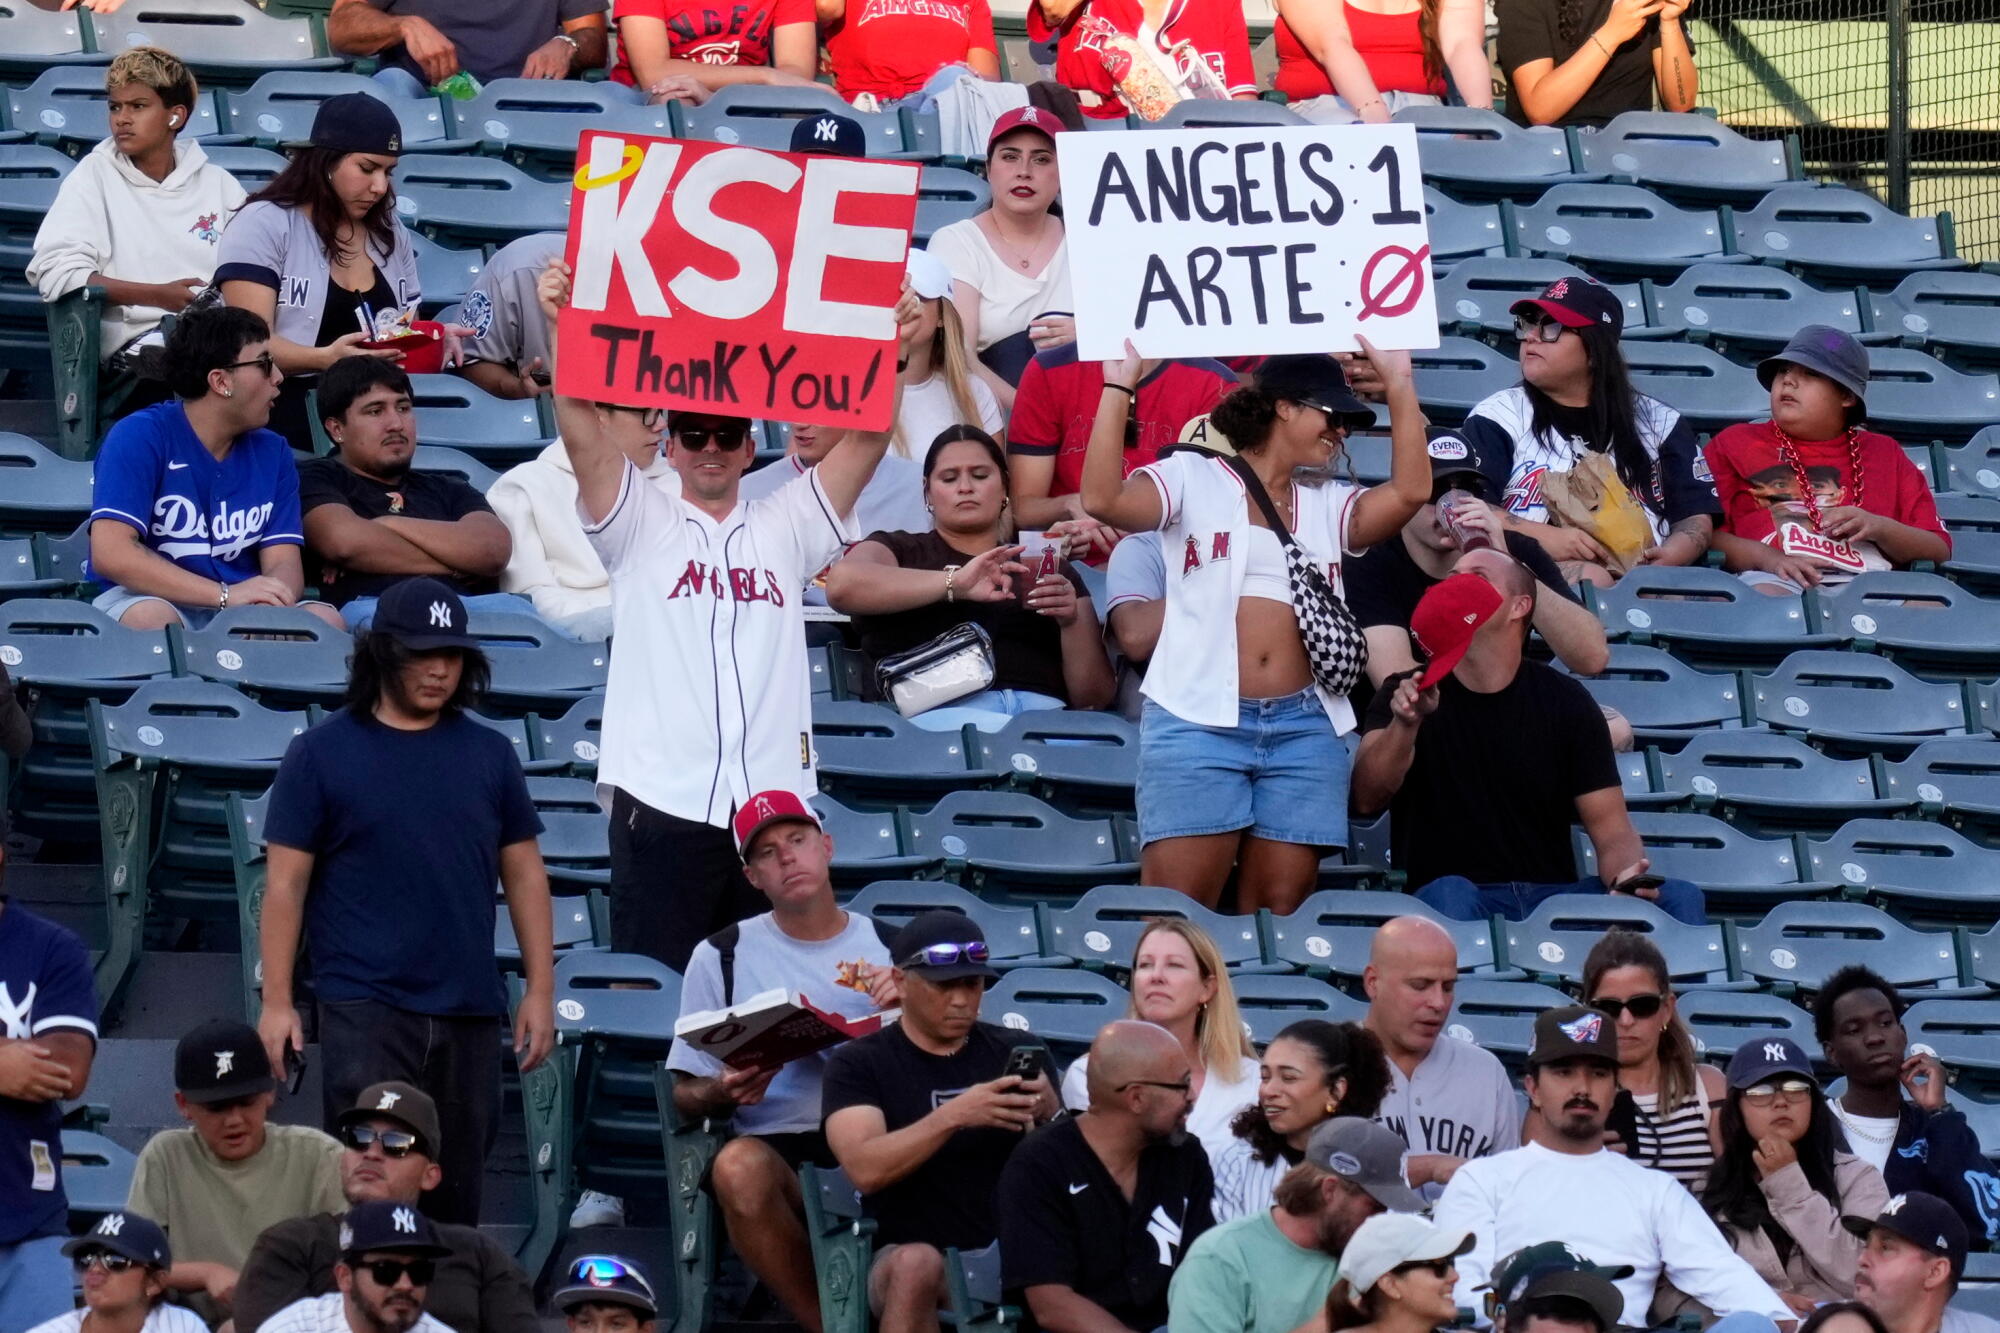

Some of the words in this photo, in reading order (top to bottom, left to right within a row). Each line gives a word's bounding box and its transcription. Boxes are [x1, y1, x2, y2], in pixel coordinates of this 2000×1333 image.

[814, 118, 839, 142] NY
[1368, 145, 1421, 225] 1
[571, 135, 920, 341] KSE
[758, 343, 883, 415] You!
[1432, 441, 1463, 451] EVENTS
[1788, 525, 1865, 564] Angels
[667, 559, 784, 608] ANGELS
[430, 600, 452, 628] NY
[1763, 1042, 1787, 1061] NY
[98, 1213, 126, 1237] NY
[392, 1207, 417, 1233] NY
